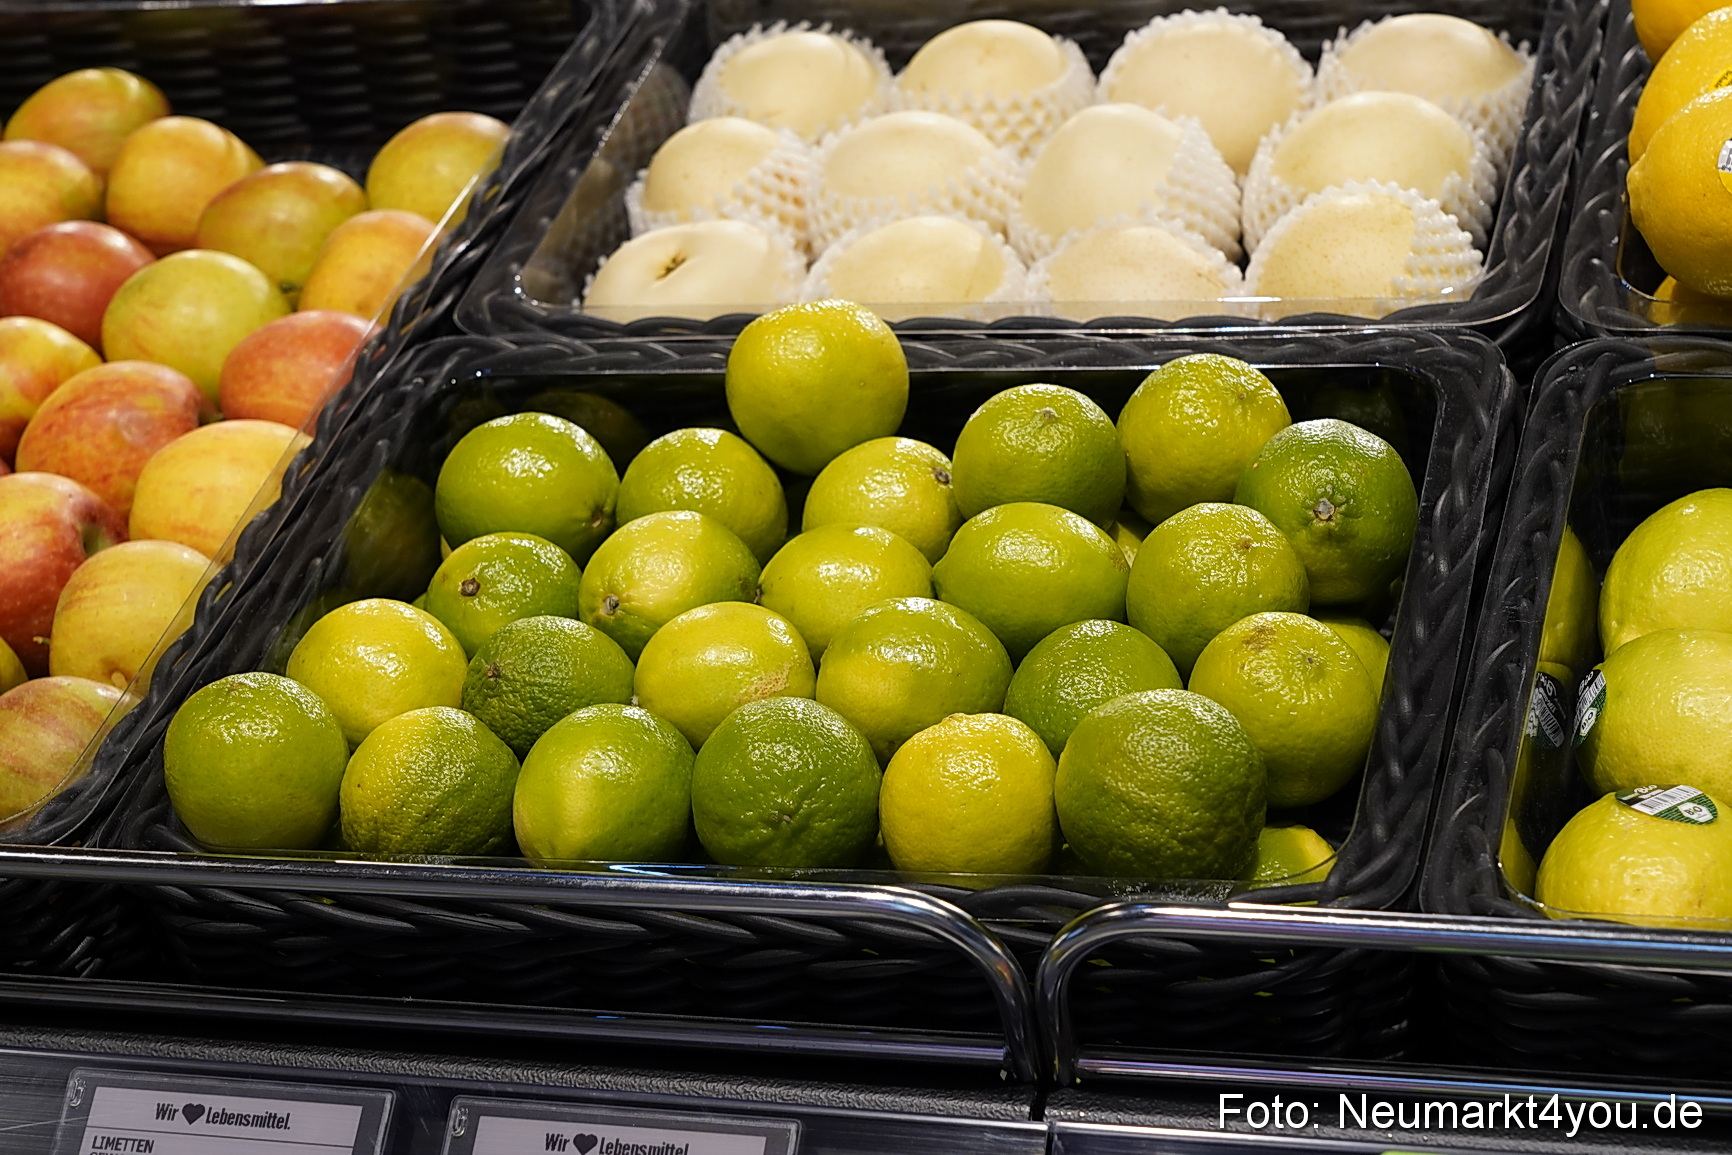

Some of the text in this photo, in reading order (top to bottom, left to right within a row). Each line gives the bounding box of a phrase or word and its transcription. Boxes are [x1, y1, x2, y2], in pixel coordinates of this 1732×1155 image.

[155, 1102, 291, 1130] Wir Lebensmittel.
[92, 1136, 155, 1153] LIMETTEN
[545, 1133, 570, 1153] Wir
